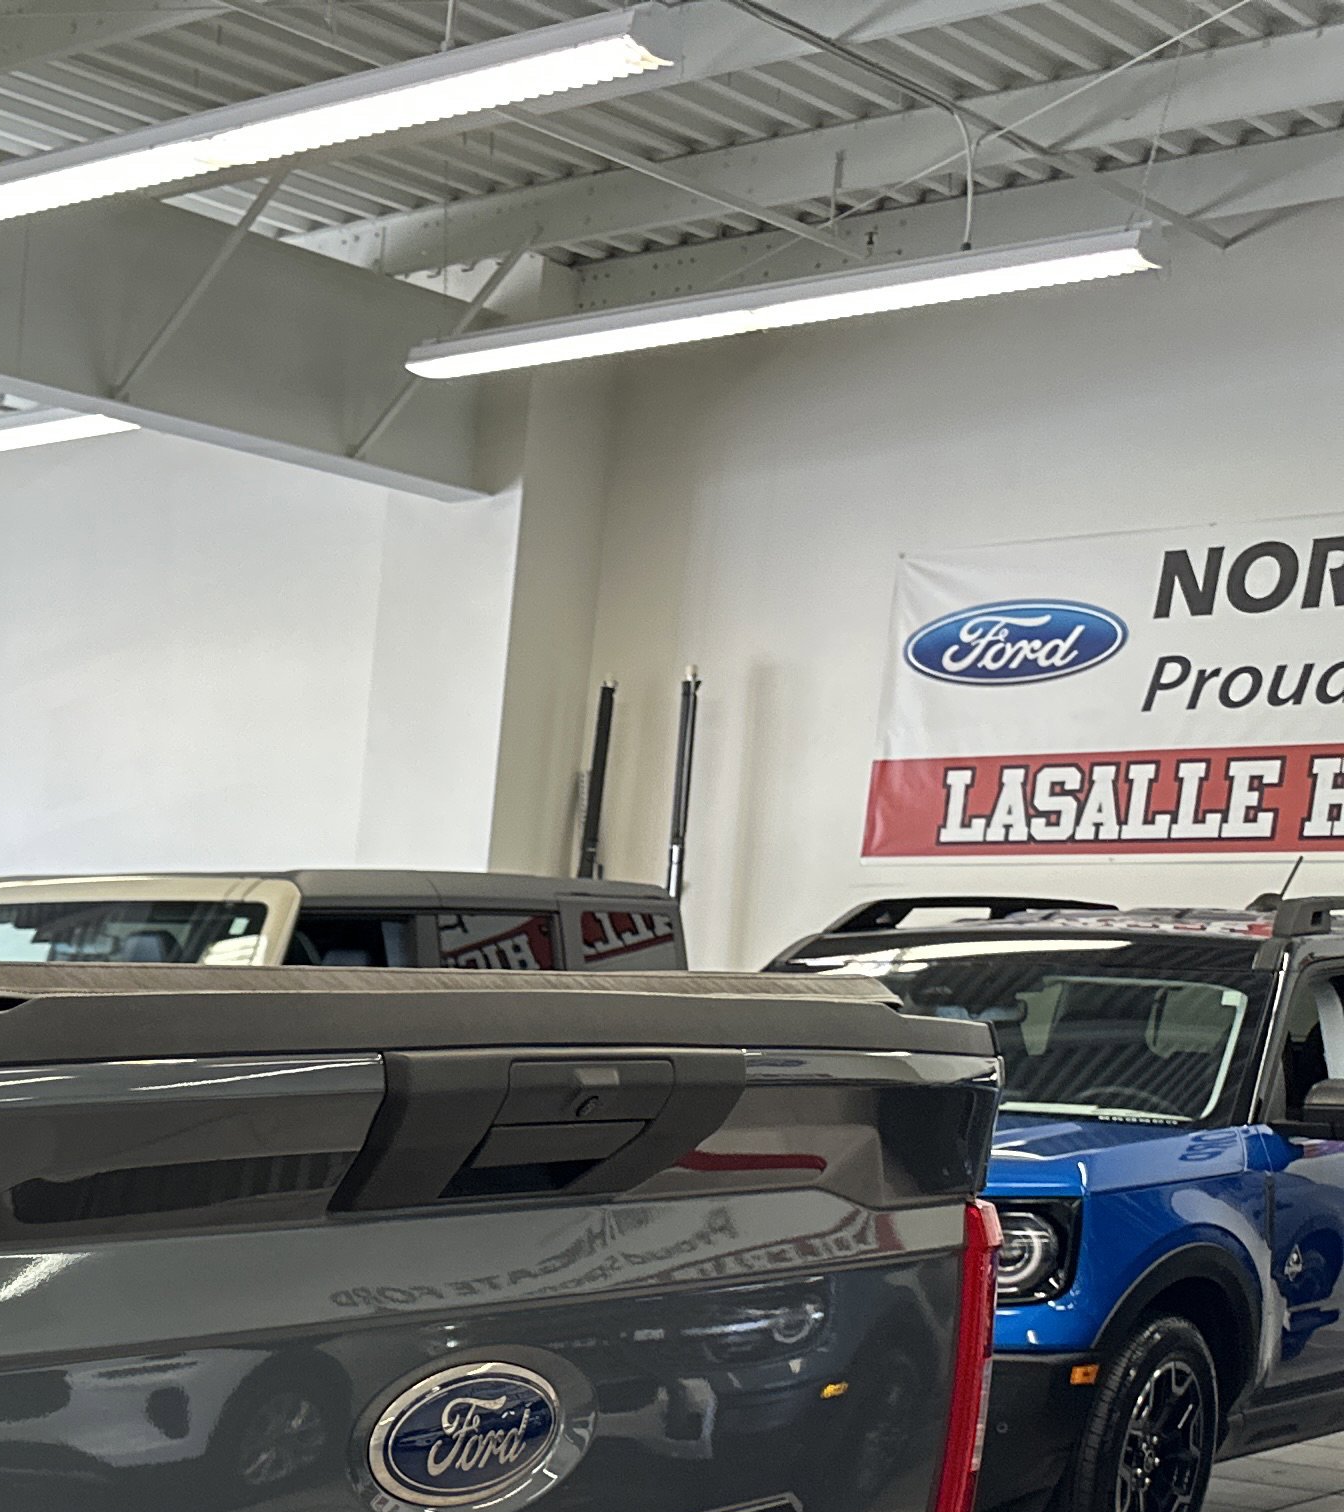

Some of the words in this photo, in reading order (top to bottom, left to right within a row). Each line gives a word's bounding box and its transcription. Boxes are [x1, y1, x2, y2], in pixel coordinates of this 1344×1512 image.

[941, 613, 1086, 673] Ford
[936, 755, 1288, 847] LASALLE
[425, 1395, 536, 1477] Ford
